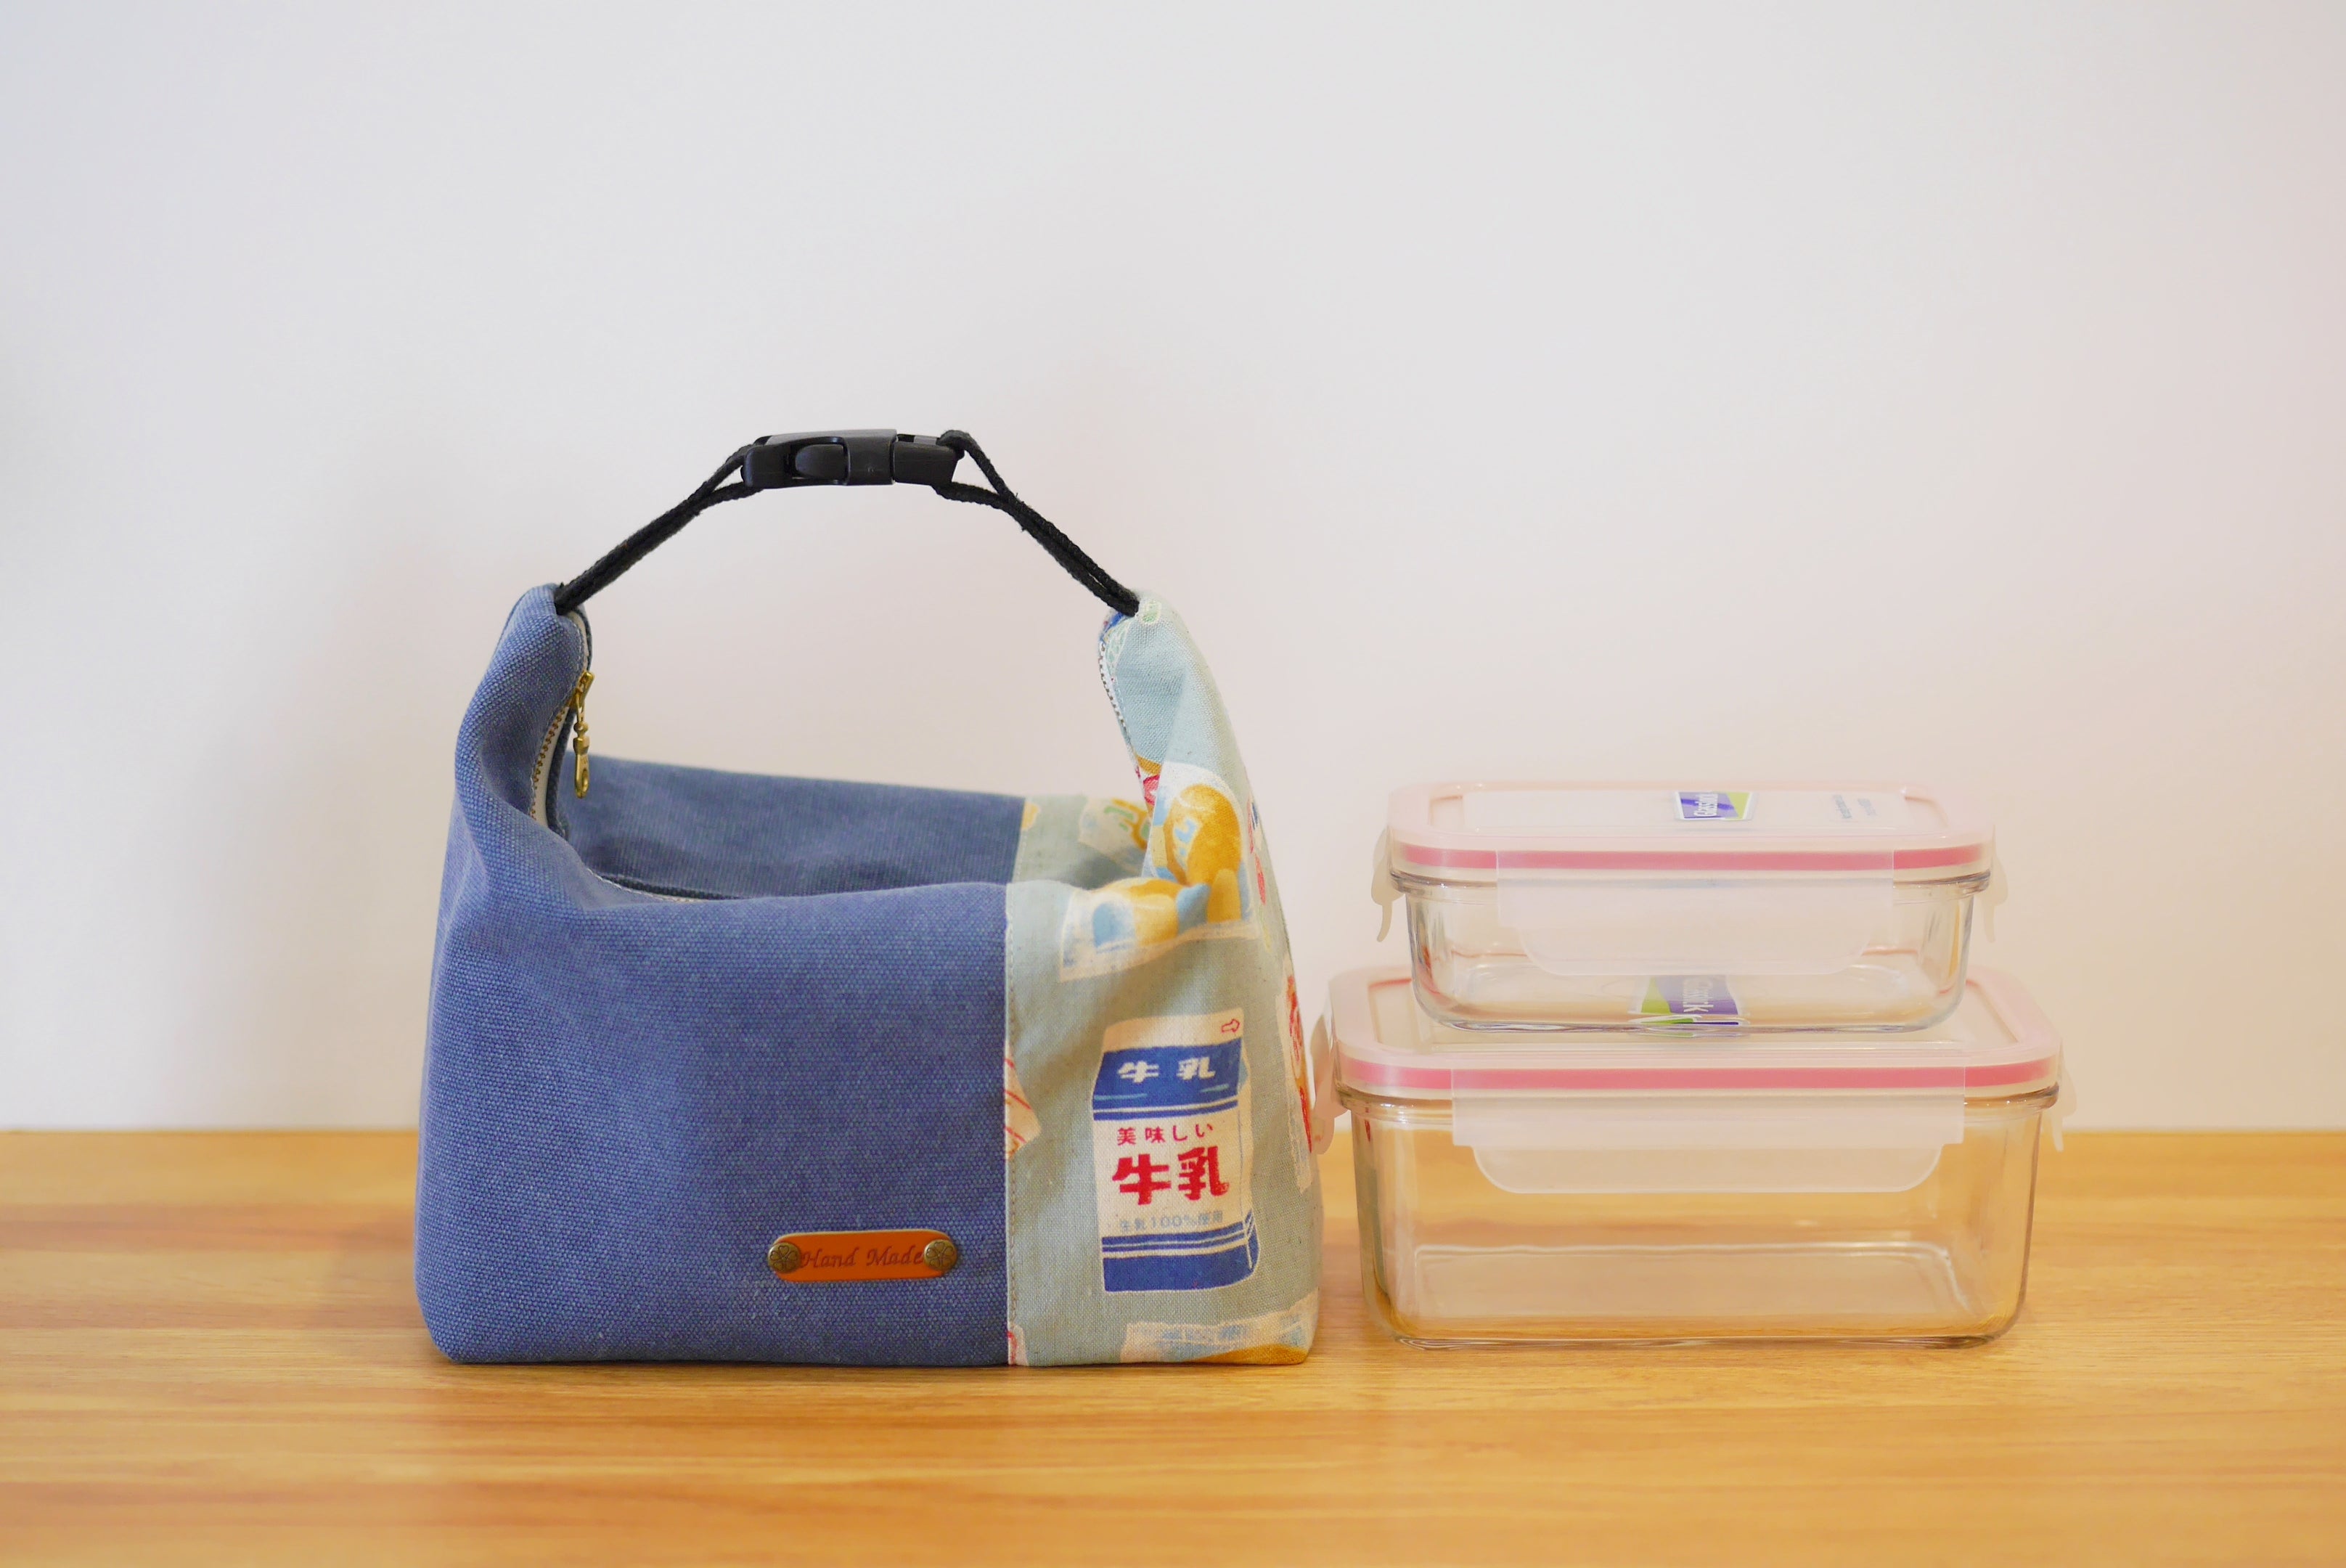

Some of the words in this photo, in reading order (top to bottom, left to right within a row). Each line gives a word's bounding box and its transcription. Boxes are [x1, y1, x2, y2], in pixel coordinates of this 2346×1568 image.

[1117, 1056, 1216, 1084] 牛乳
[1116, 1123, 1214, 1146] 美味しい
[1112, 1146, 1230, 1206] 牛乳
[800, 1246, 859, 1269] Hand
[866, 1244, 924, 1266] Made
